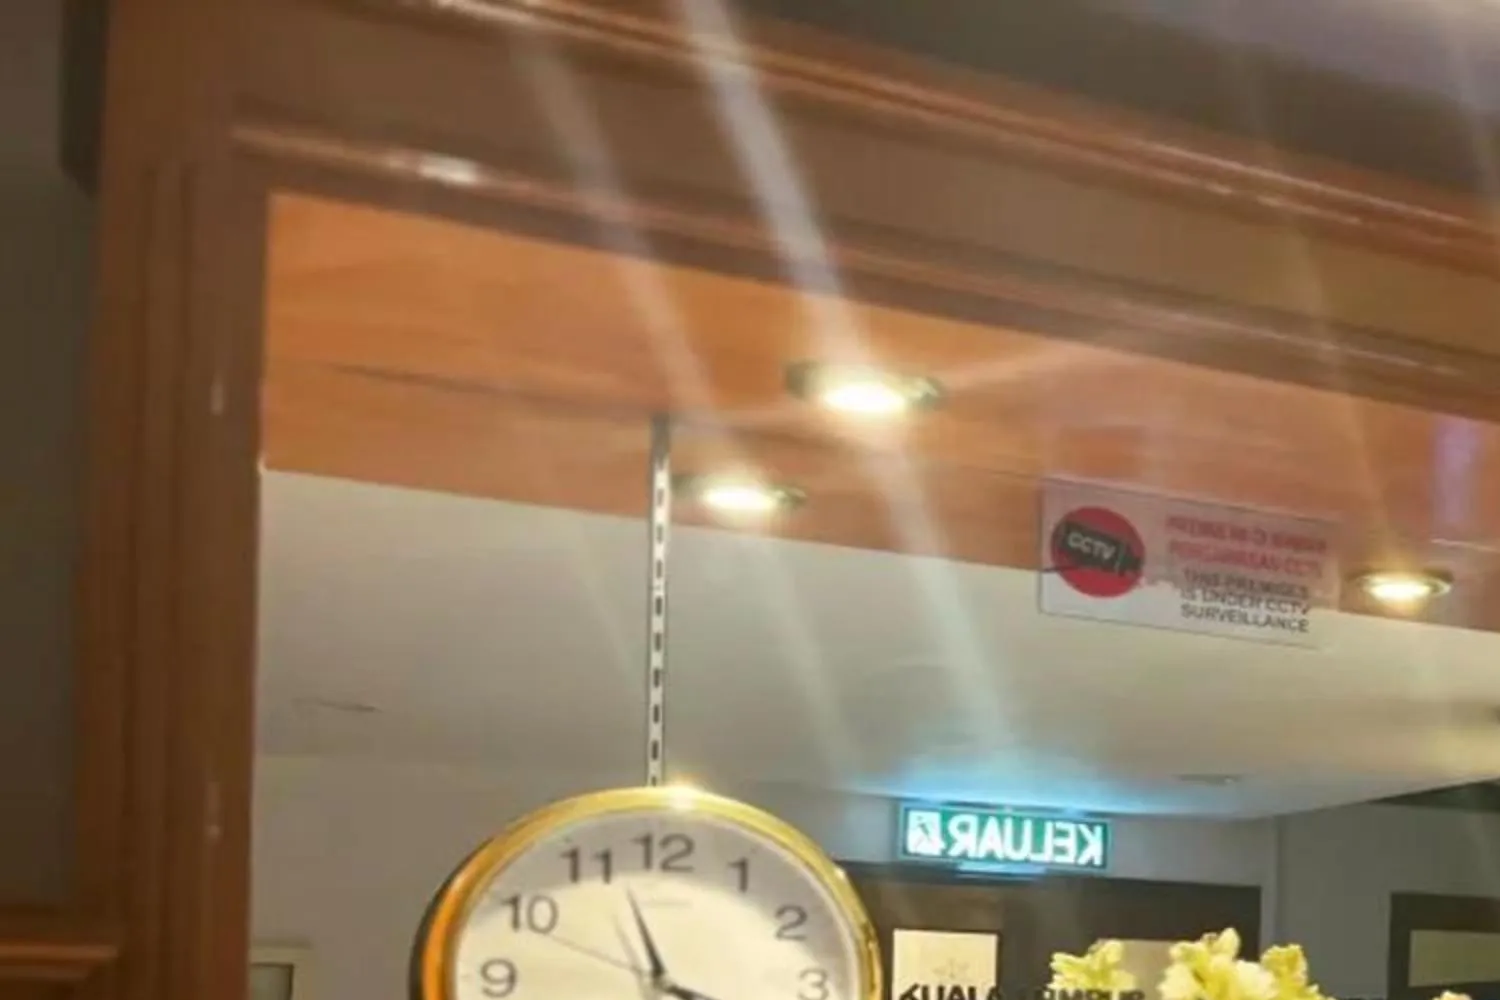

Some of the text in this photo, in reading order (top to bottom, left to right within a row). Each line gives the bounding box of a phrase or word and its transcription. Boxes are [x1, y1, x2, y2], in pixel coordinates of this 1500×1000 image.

[1067, 531, 1116, 561] CCTV
[1180, 603, 1311, 634] SURVEILLANCE
[1265, 597, 1312, 617] CCTV
[561, 848, 613, 884] 11
[633, 832, 695, 873] 12
[728, 857, 750, 892] 1
[504, 893, 559, 935] 10
[773, 904, 809, 941] 2
[479, 957, 518, 999] 9
